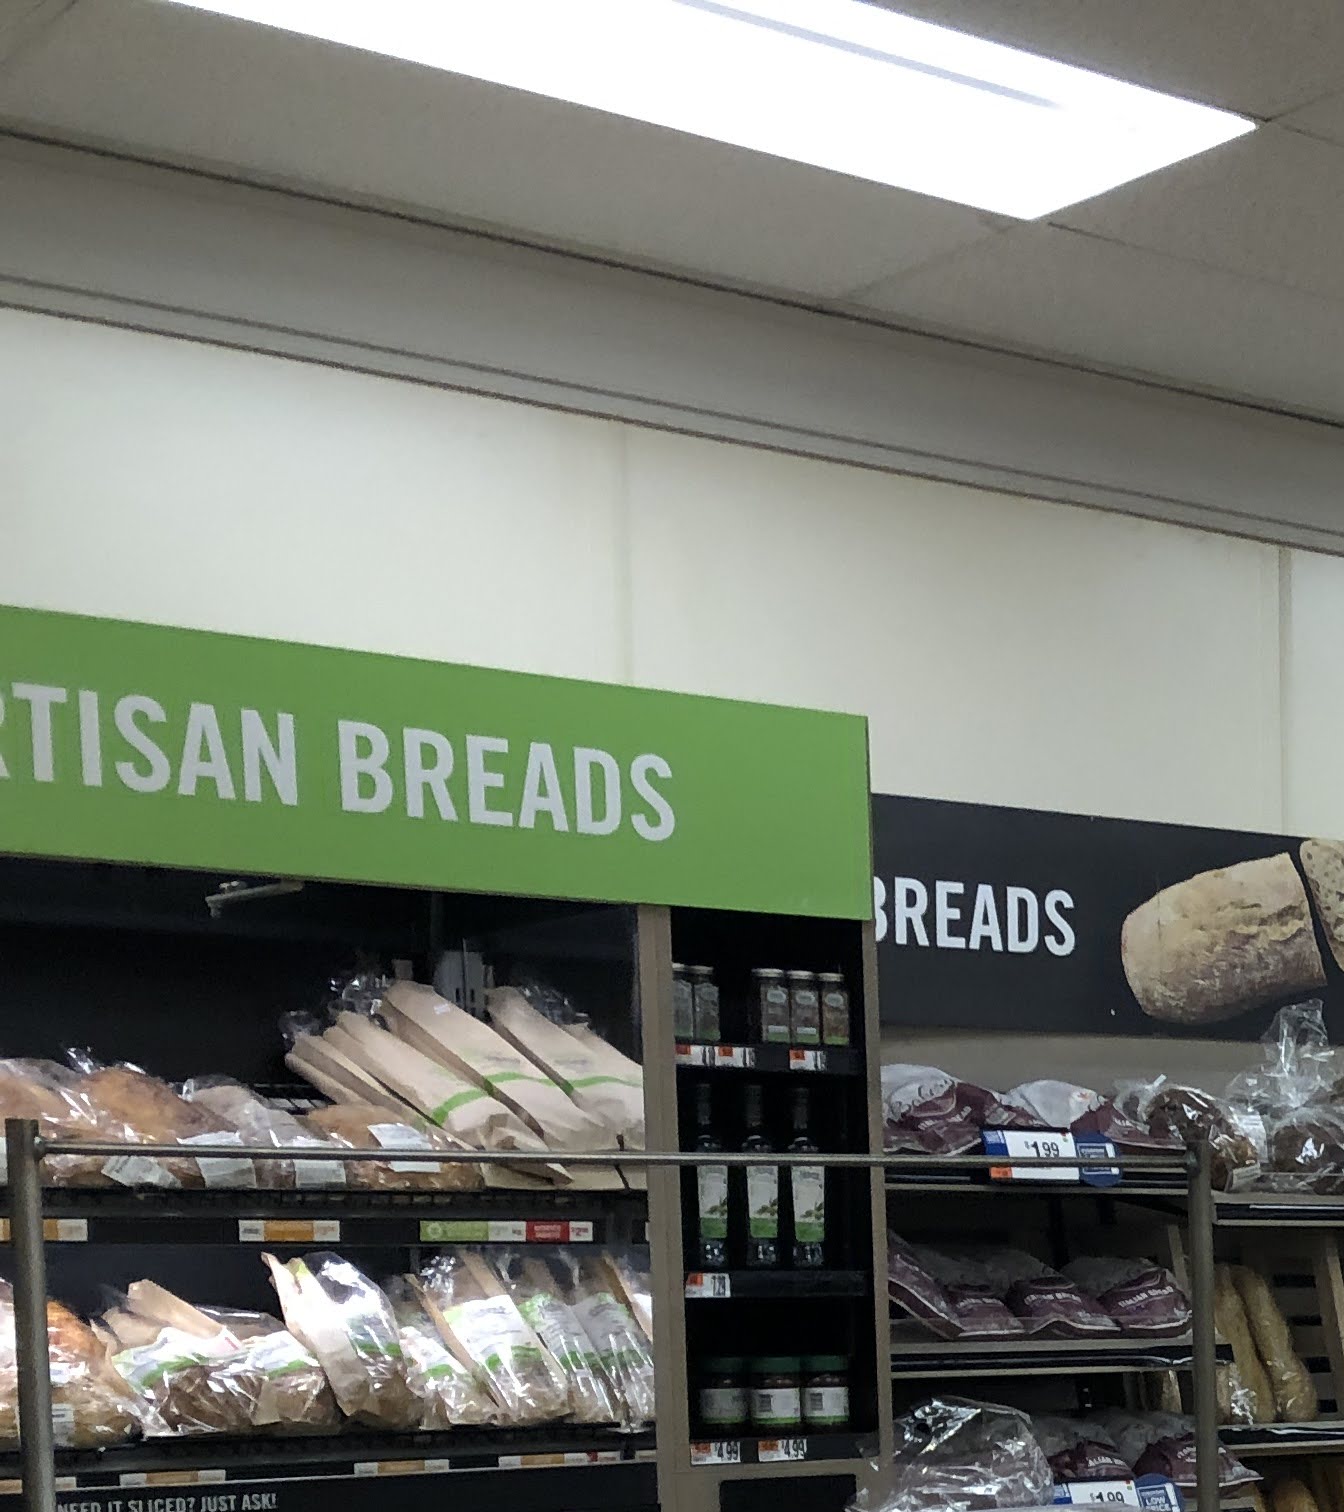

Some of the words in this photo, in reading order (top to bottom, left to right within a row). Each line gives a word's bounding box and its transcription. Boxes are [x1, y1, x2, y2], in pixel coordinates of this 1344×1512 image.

[0, 682, 298, 807] TISAN
[337, 719, 676, 842] BREADS
[200, 1494, 237, 1512] JUST
[241, 1492, 278, 1512] ASK!
